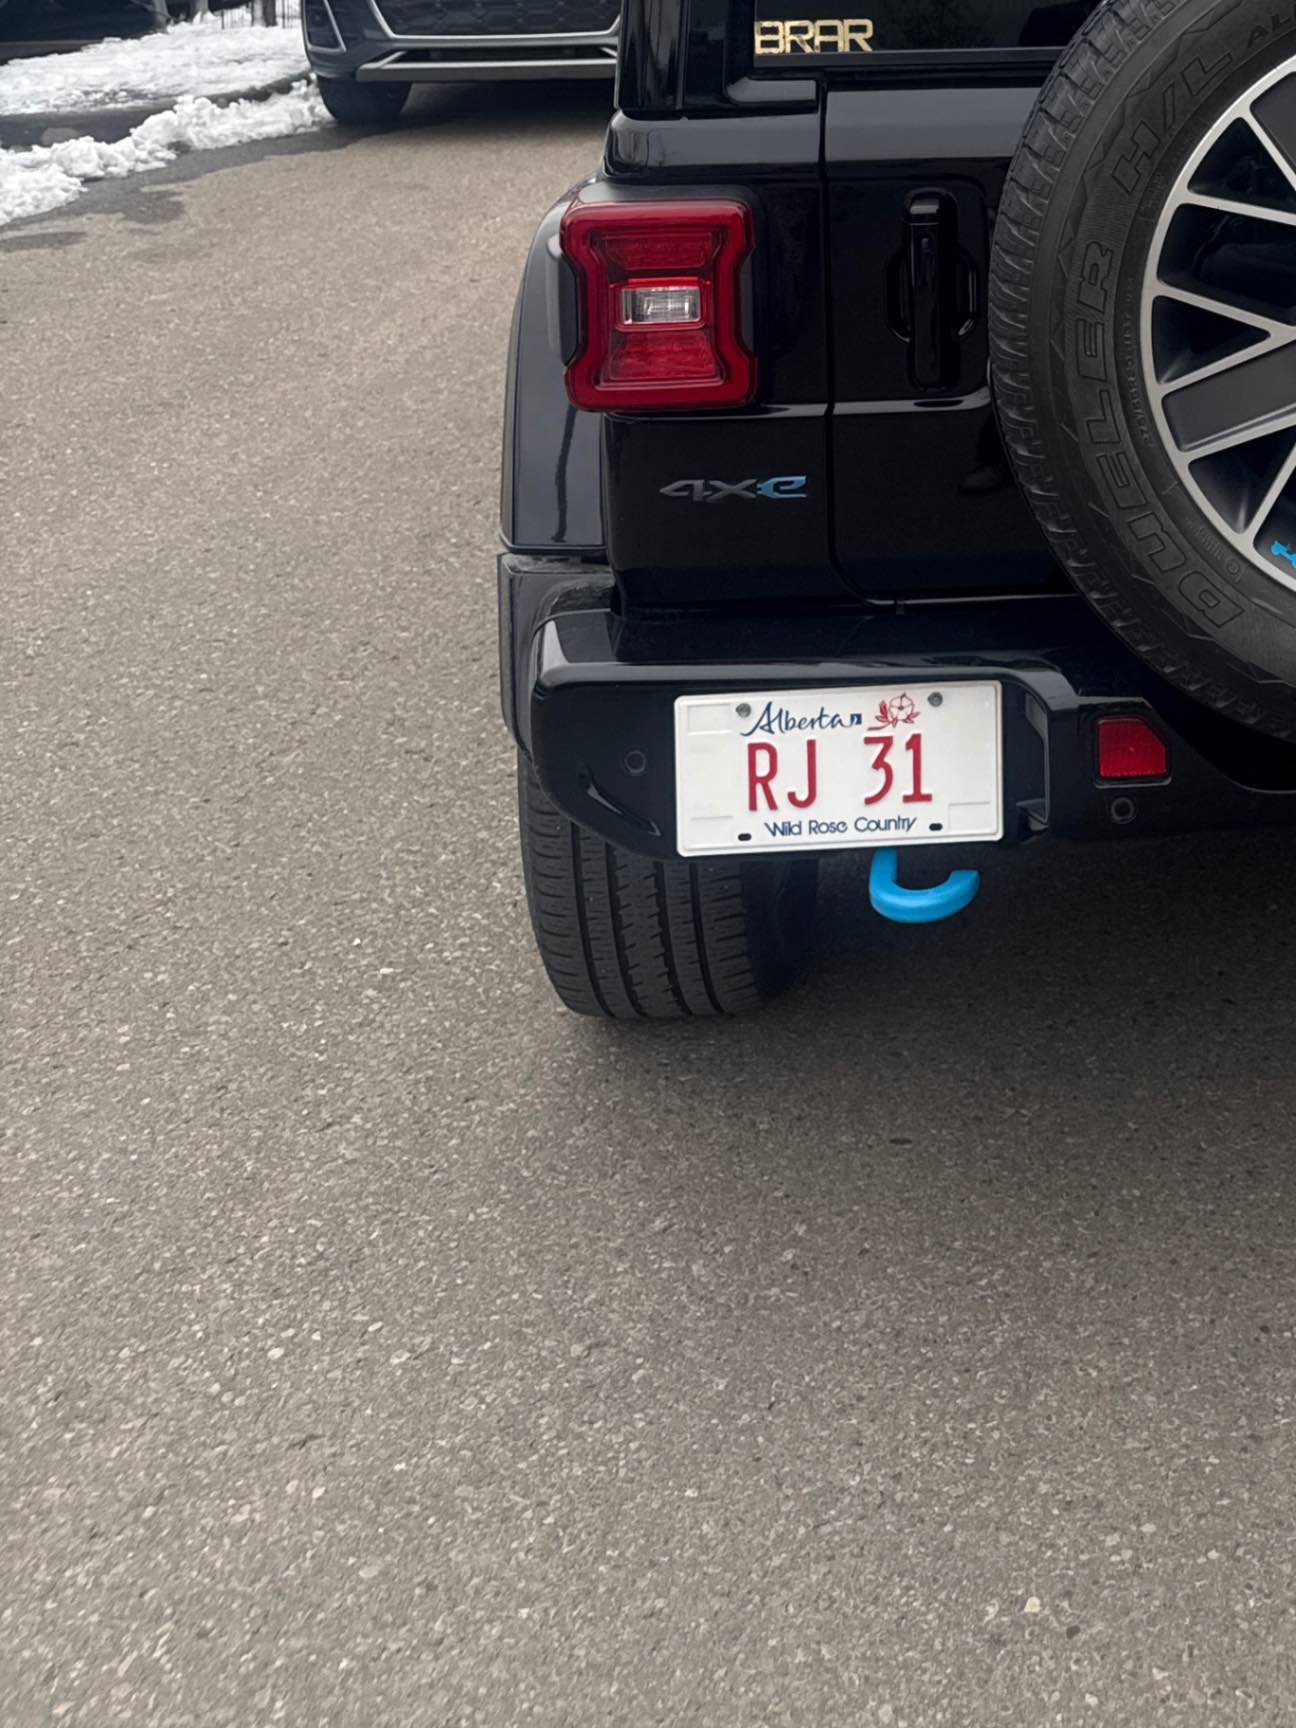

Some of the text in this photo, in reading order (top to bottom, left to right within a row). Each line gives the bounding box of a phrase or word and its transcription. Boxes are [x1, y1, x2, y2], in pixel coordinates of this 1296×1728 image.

[754, 18, 873, 55] BRAR
[740, 701, 848, 736] Alberta
[747, 733, 932, 812] RJ 31
[764, 816, 917, 837] Wild Rose Country
